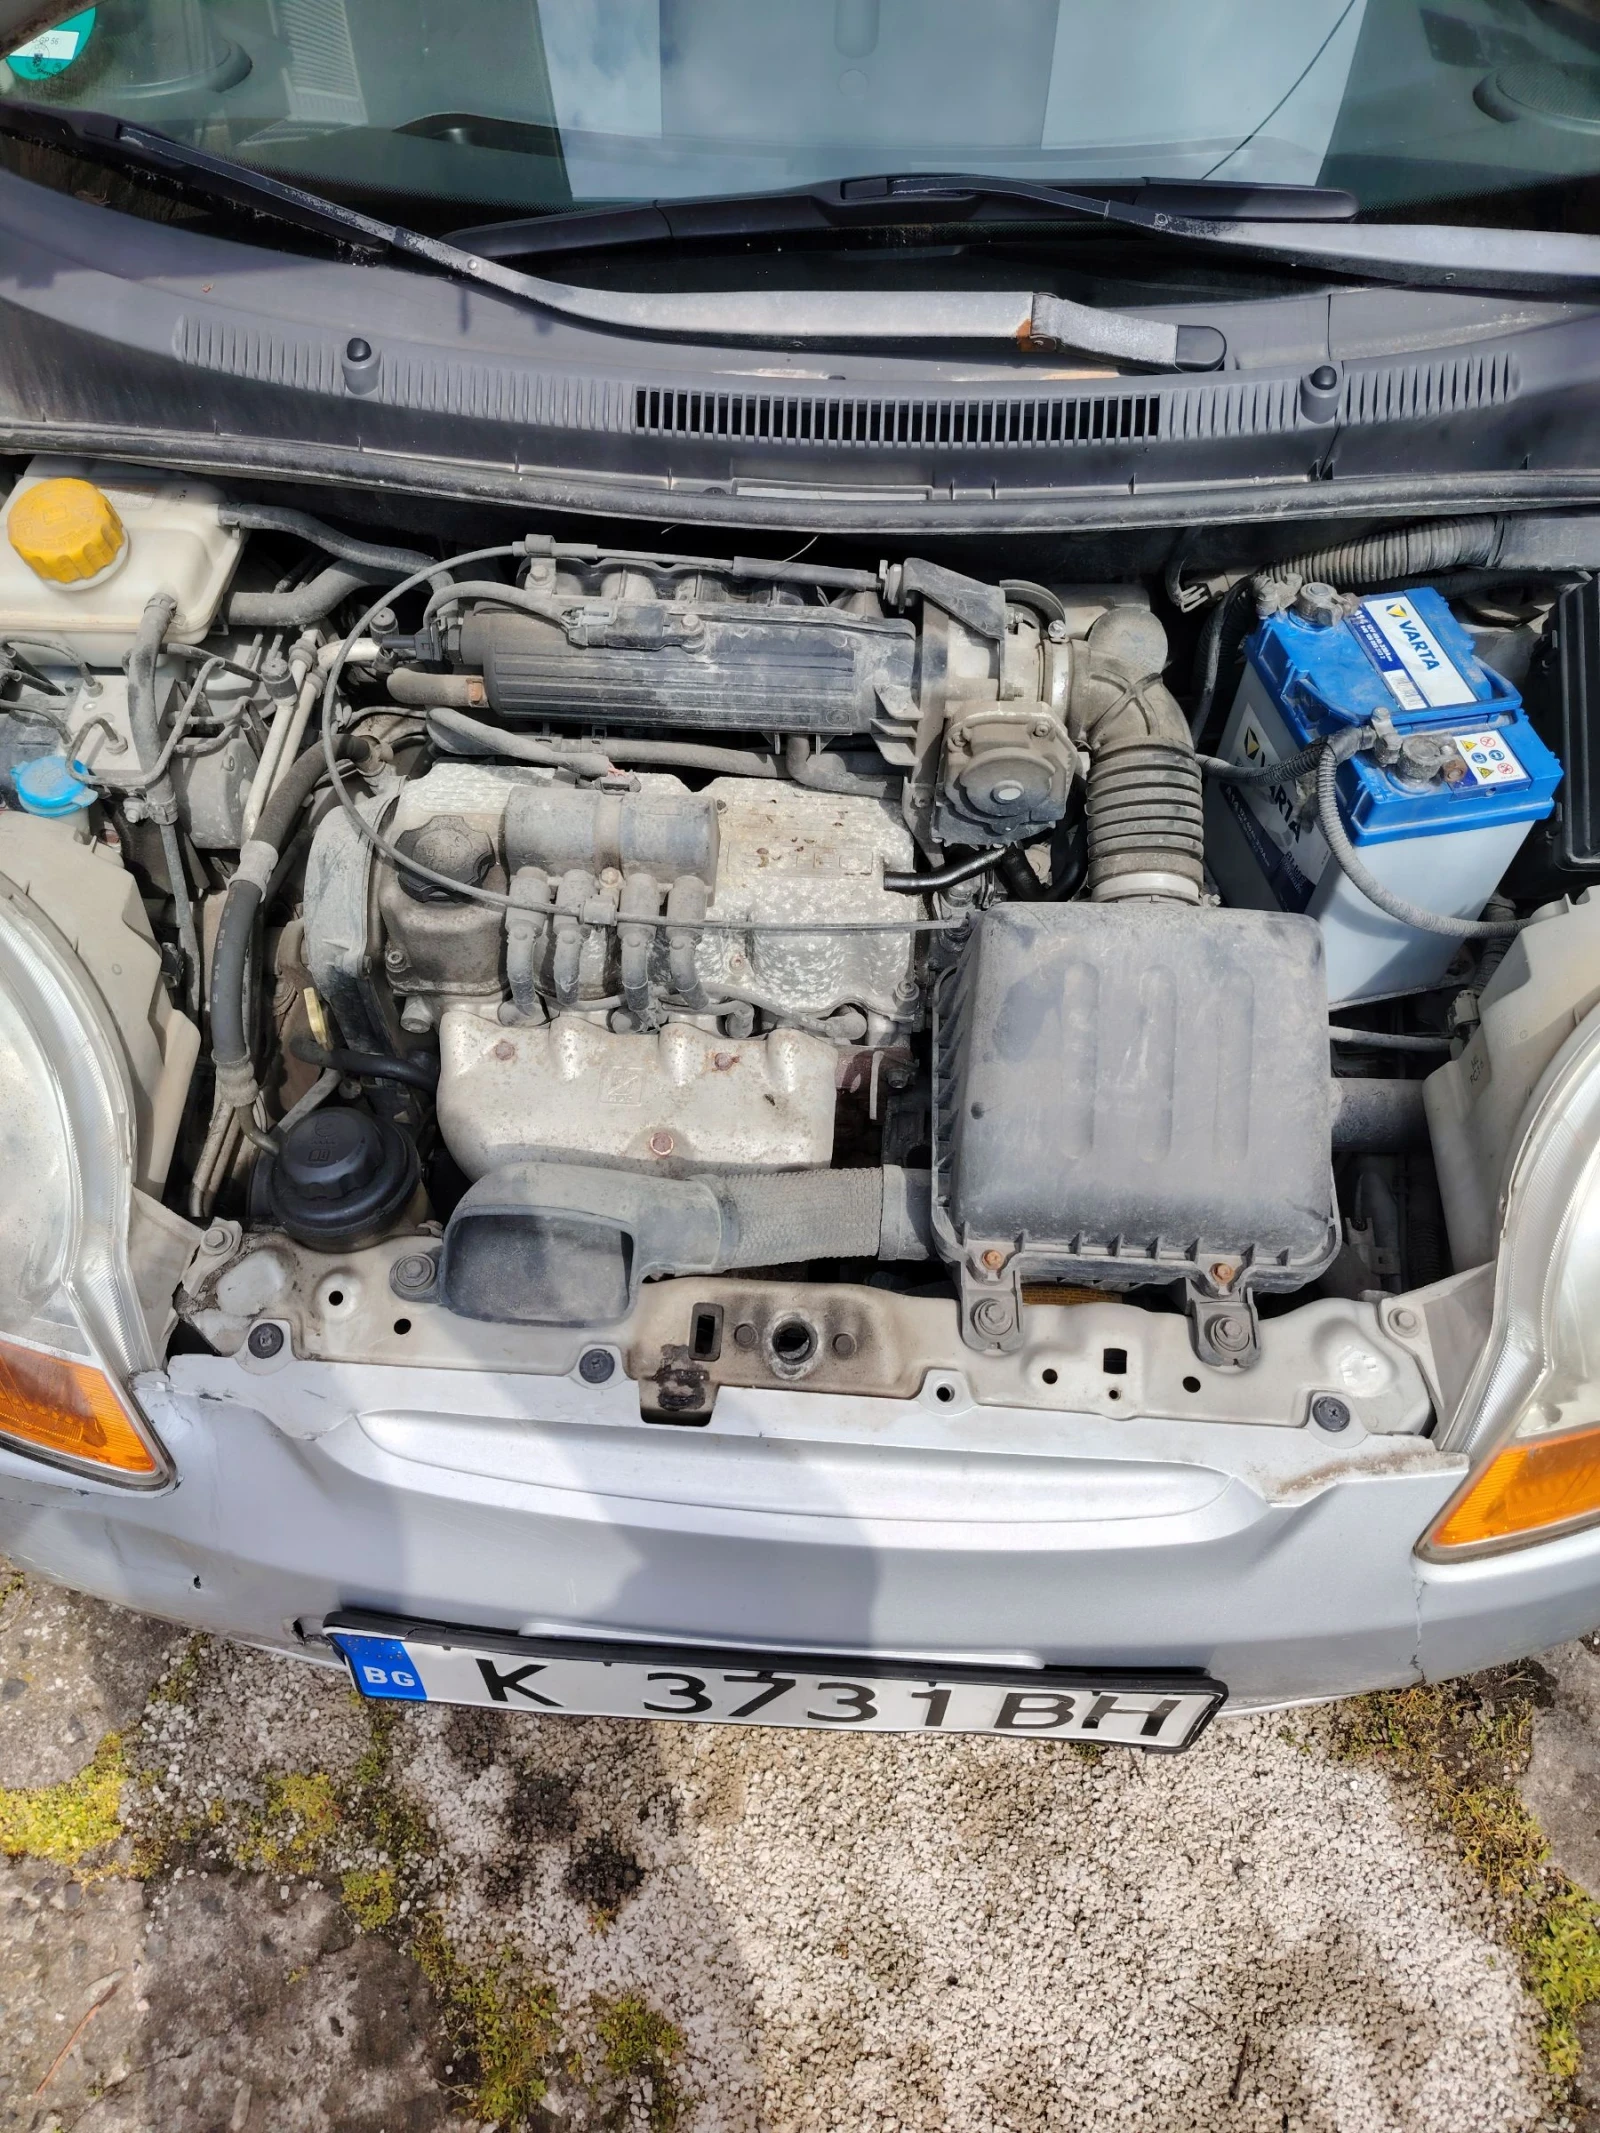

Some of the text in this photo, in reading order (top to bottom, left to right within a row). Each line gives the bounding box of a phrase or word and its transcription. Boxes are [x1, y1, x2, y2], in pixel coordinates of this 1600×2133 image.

[1399, 620, 1440, 670] VARTA
[1260, 751, 1301, 844] RTA
[363, 1666, 415, 1686] BG
[475, 1658, 1181, 1737] K 3731 BH
